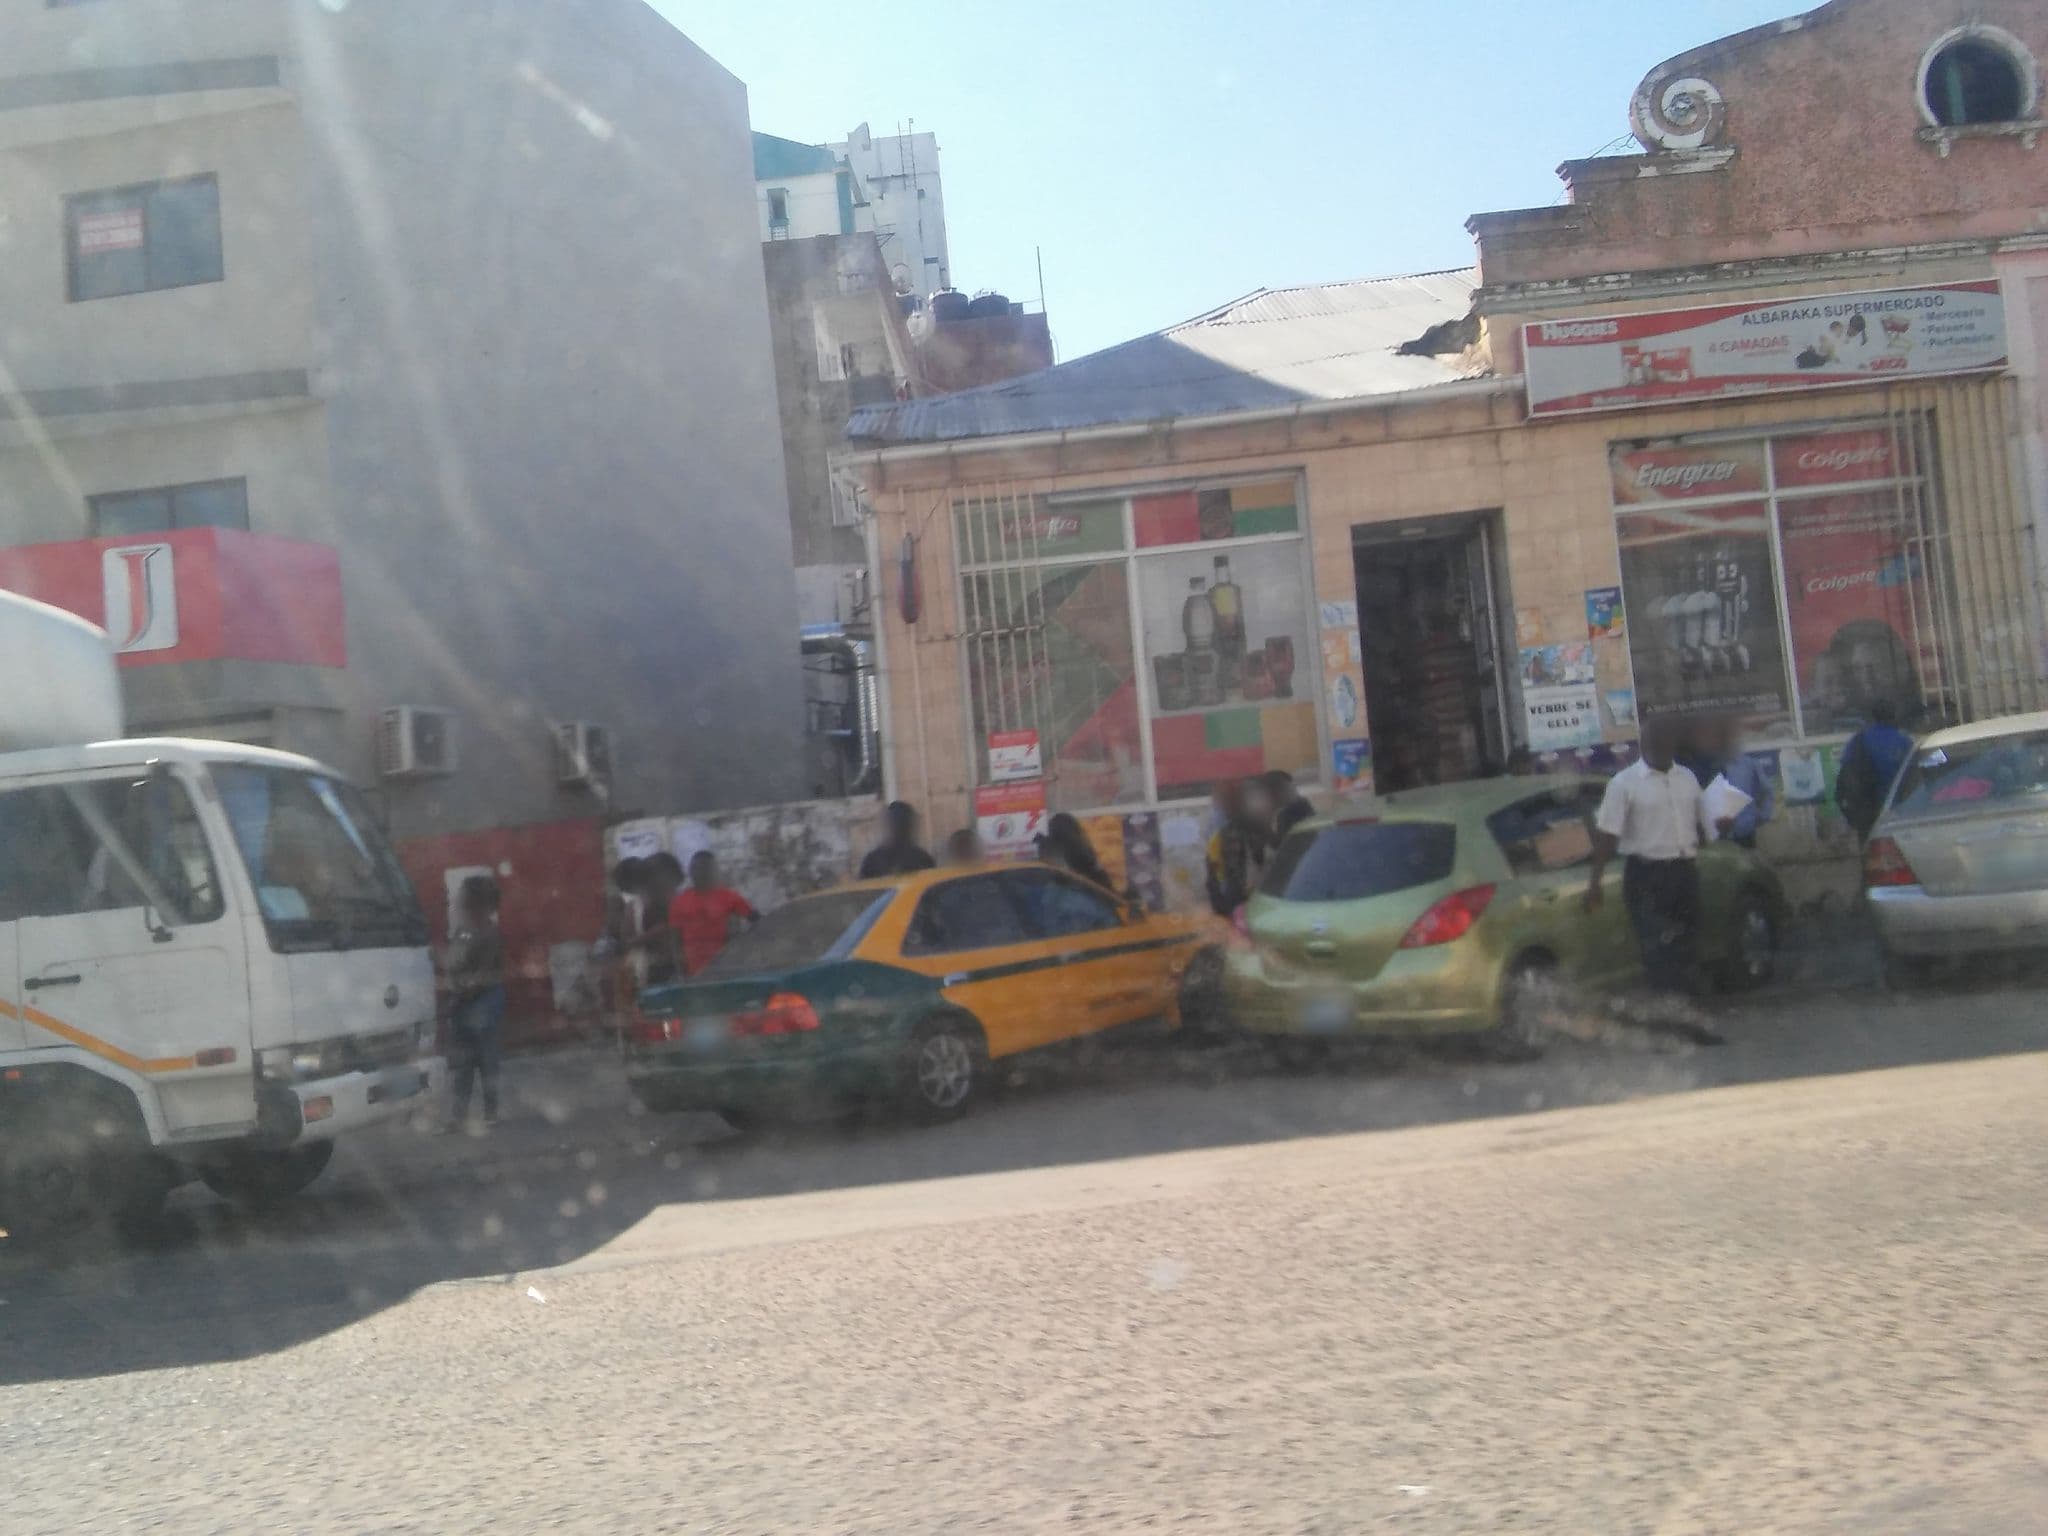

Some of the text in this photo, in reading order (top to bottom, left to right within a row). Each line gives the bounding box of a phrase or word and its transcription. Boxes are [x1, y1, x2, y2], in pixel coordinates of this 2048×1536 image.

[1742, 295, 1944, 326] ALBARAKA SUPERMERCADO
[1719, 335, 1790, 352] CAMADAS
[1798, 446, 1885, 471] Colgate
[1635, 459, 1739, 490] Energizer
[1806, 568, 1877, 593] Colgate
